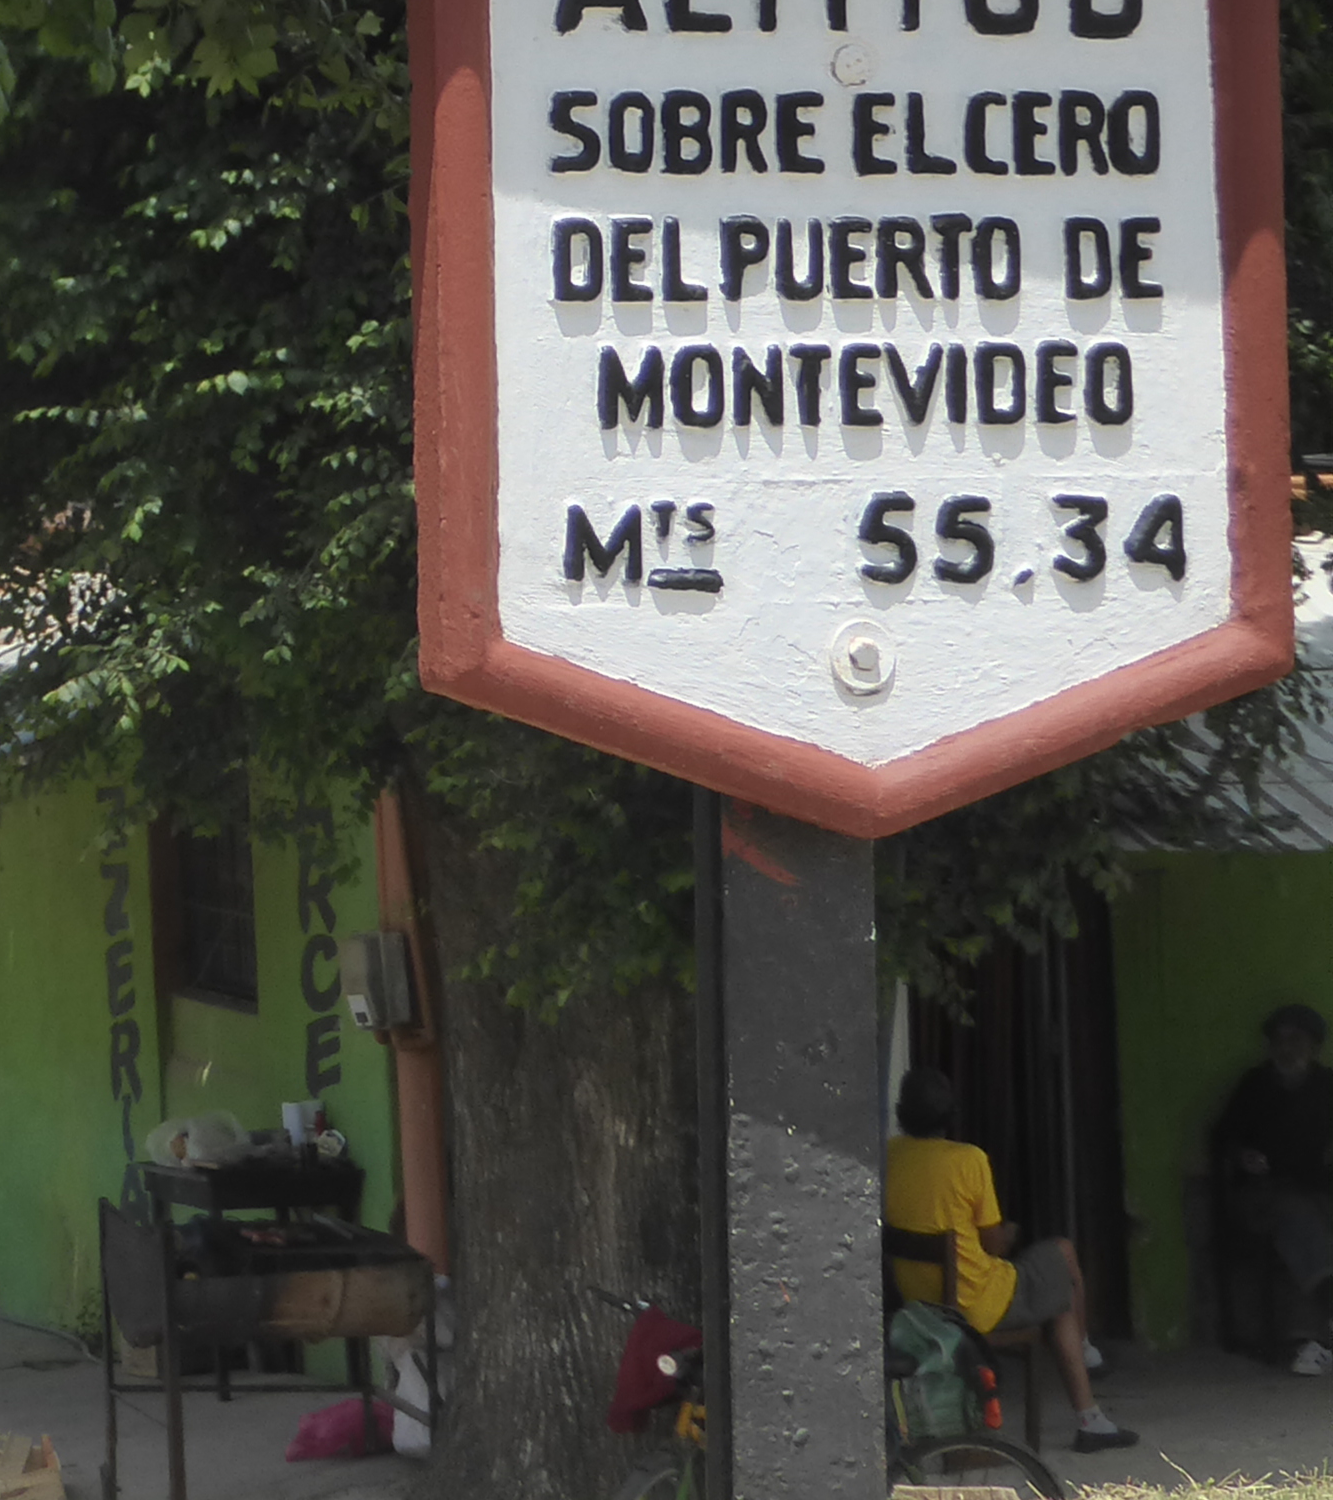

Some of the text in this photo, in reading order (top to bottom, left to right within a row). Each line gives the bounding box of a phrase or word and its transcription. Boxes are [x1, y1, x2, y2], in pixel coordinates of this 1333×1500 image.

[549, 88, 826, 176] SOBRE
[551, 214, 1165, 302] DEL PUERTO DE
[597, 340, 1135, 430] MONTEVIDEO
[858, 491, 1188, 587] 55.34
